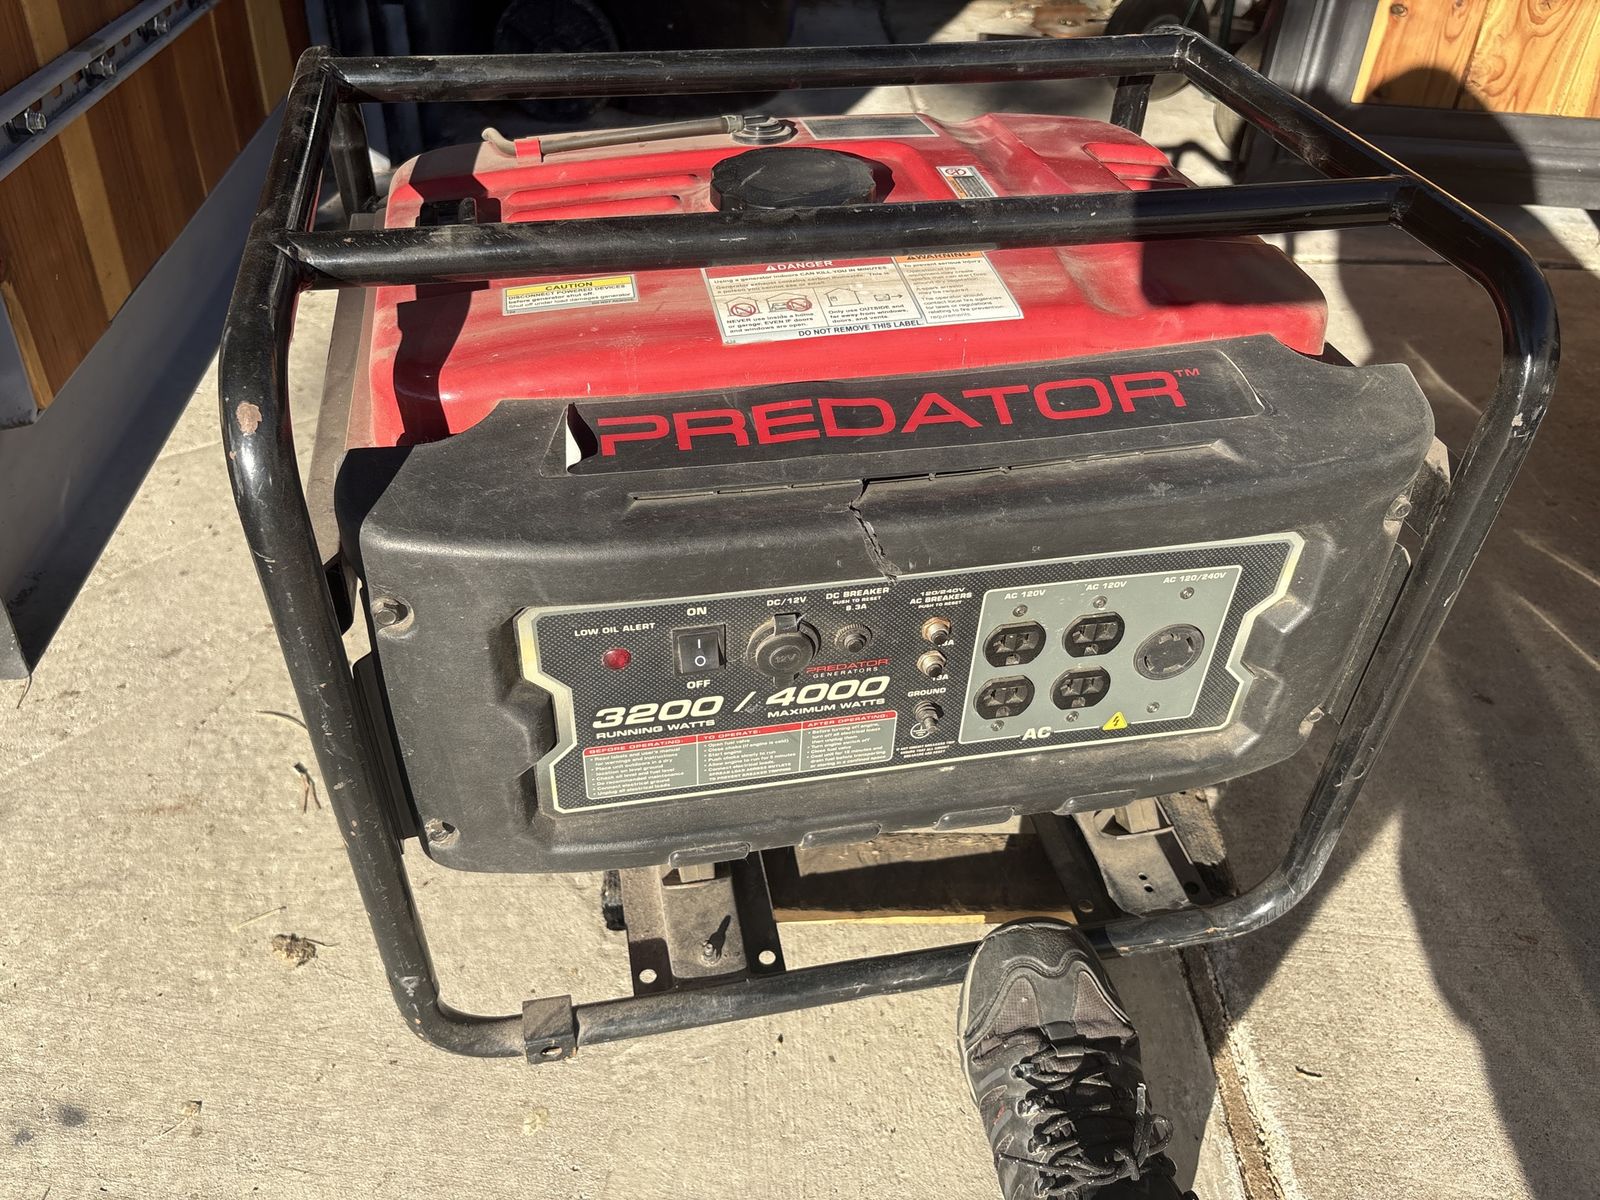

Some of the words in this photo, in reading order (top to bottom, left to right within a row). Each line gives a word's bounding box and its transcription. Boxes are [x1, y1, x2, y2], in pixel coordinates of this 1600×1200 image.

[776, 261, 833, 269] DANGER
[545, 281, 592, 290] CAUTION
[832, 324, 870, 333] REMOVE
[1162, 576, 1177, 584] AC
[1179, 572, 1227, 583] 120/240V
[1086, 583, 1100, 591] AC
[1102, 580, 1127, 590] 120V
[825, 592, 840, 600] DC
[843, 586, 890, 598] BREAKER
[920, 587, 966, 597] 120/240V
[1004, 592, 1018, 600] AC
[1020, 589, 1046, 599] 120V
[767, 596, 808, 607] DC/12V
[864, 595, 882, 603] RESET
[925, 592, 973, 604] BREAKERS
[687, 607, 707, 617] ON
[846, 602, 867, 611] 8.3A
[574, 627, 599, 637] LOW
[601, 626, 620, 635] OIL
[622, 622, 656, 633] ALERT
[806, 658, 890, 674] PREDATOR
[813, 666, 879, 678] GENERATORS
[686, 679, 711, 689] OFF
[907, 687, 947, 698] GROUND
[592, 695, 725, 729] 3200
[734, 691, 757, 713] /
[766, 675, 891, 707] 4000
[767, 703, 837, 718] MAXIMUM
[839, 697, 886, 711] WATTS
[596, 725, 664, 740] RUNNING
[667, 719, 715, 732] WATTS
[1022, 726, 1052, 740] AC
[589, 745, 625, 754] BEFORE
